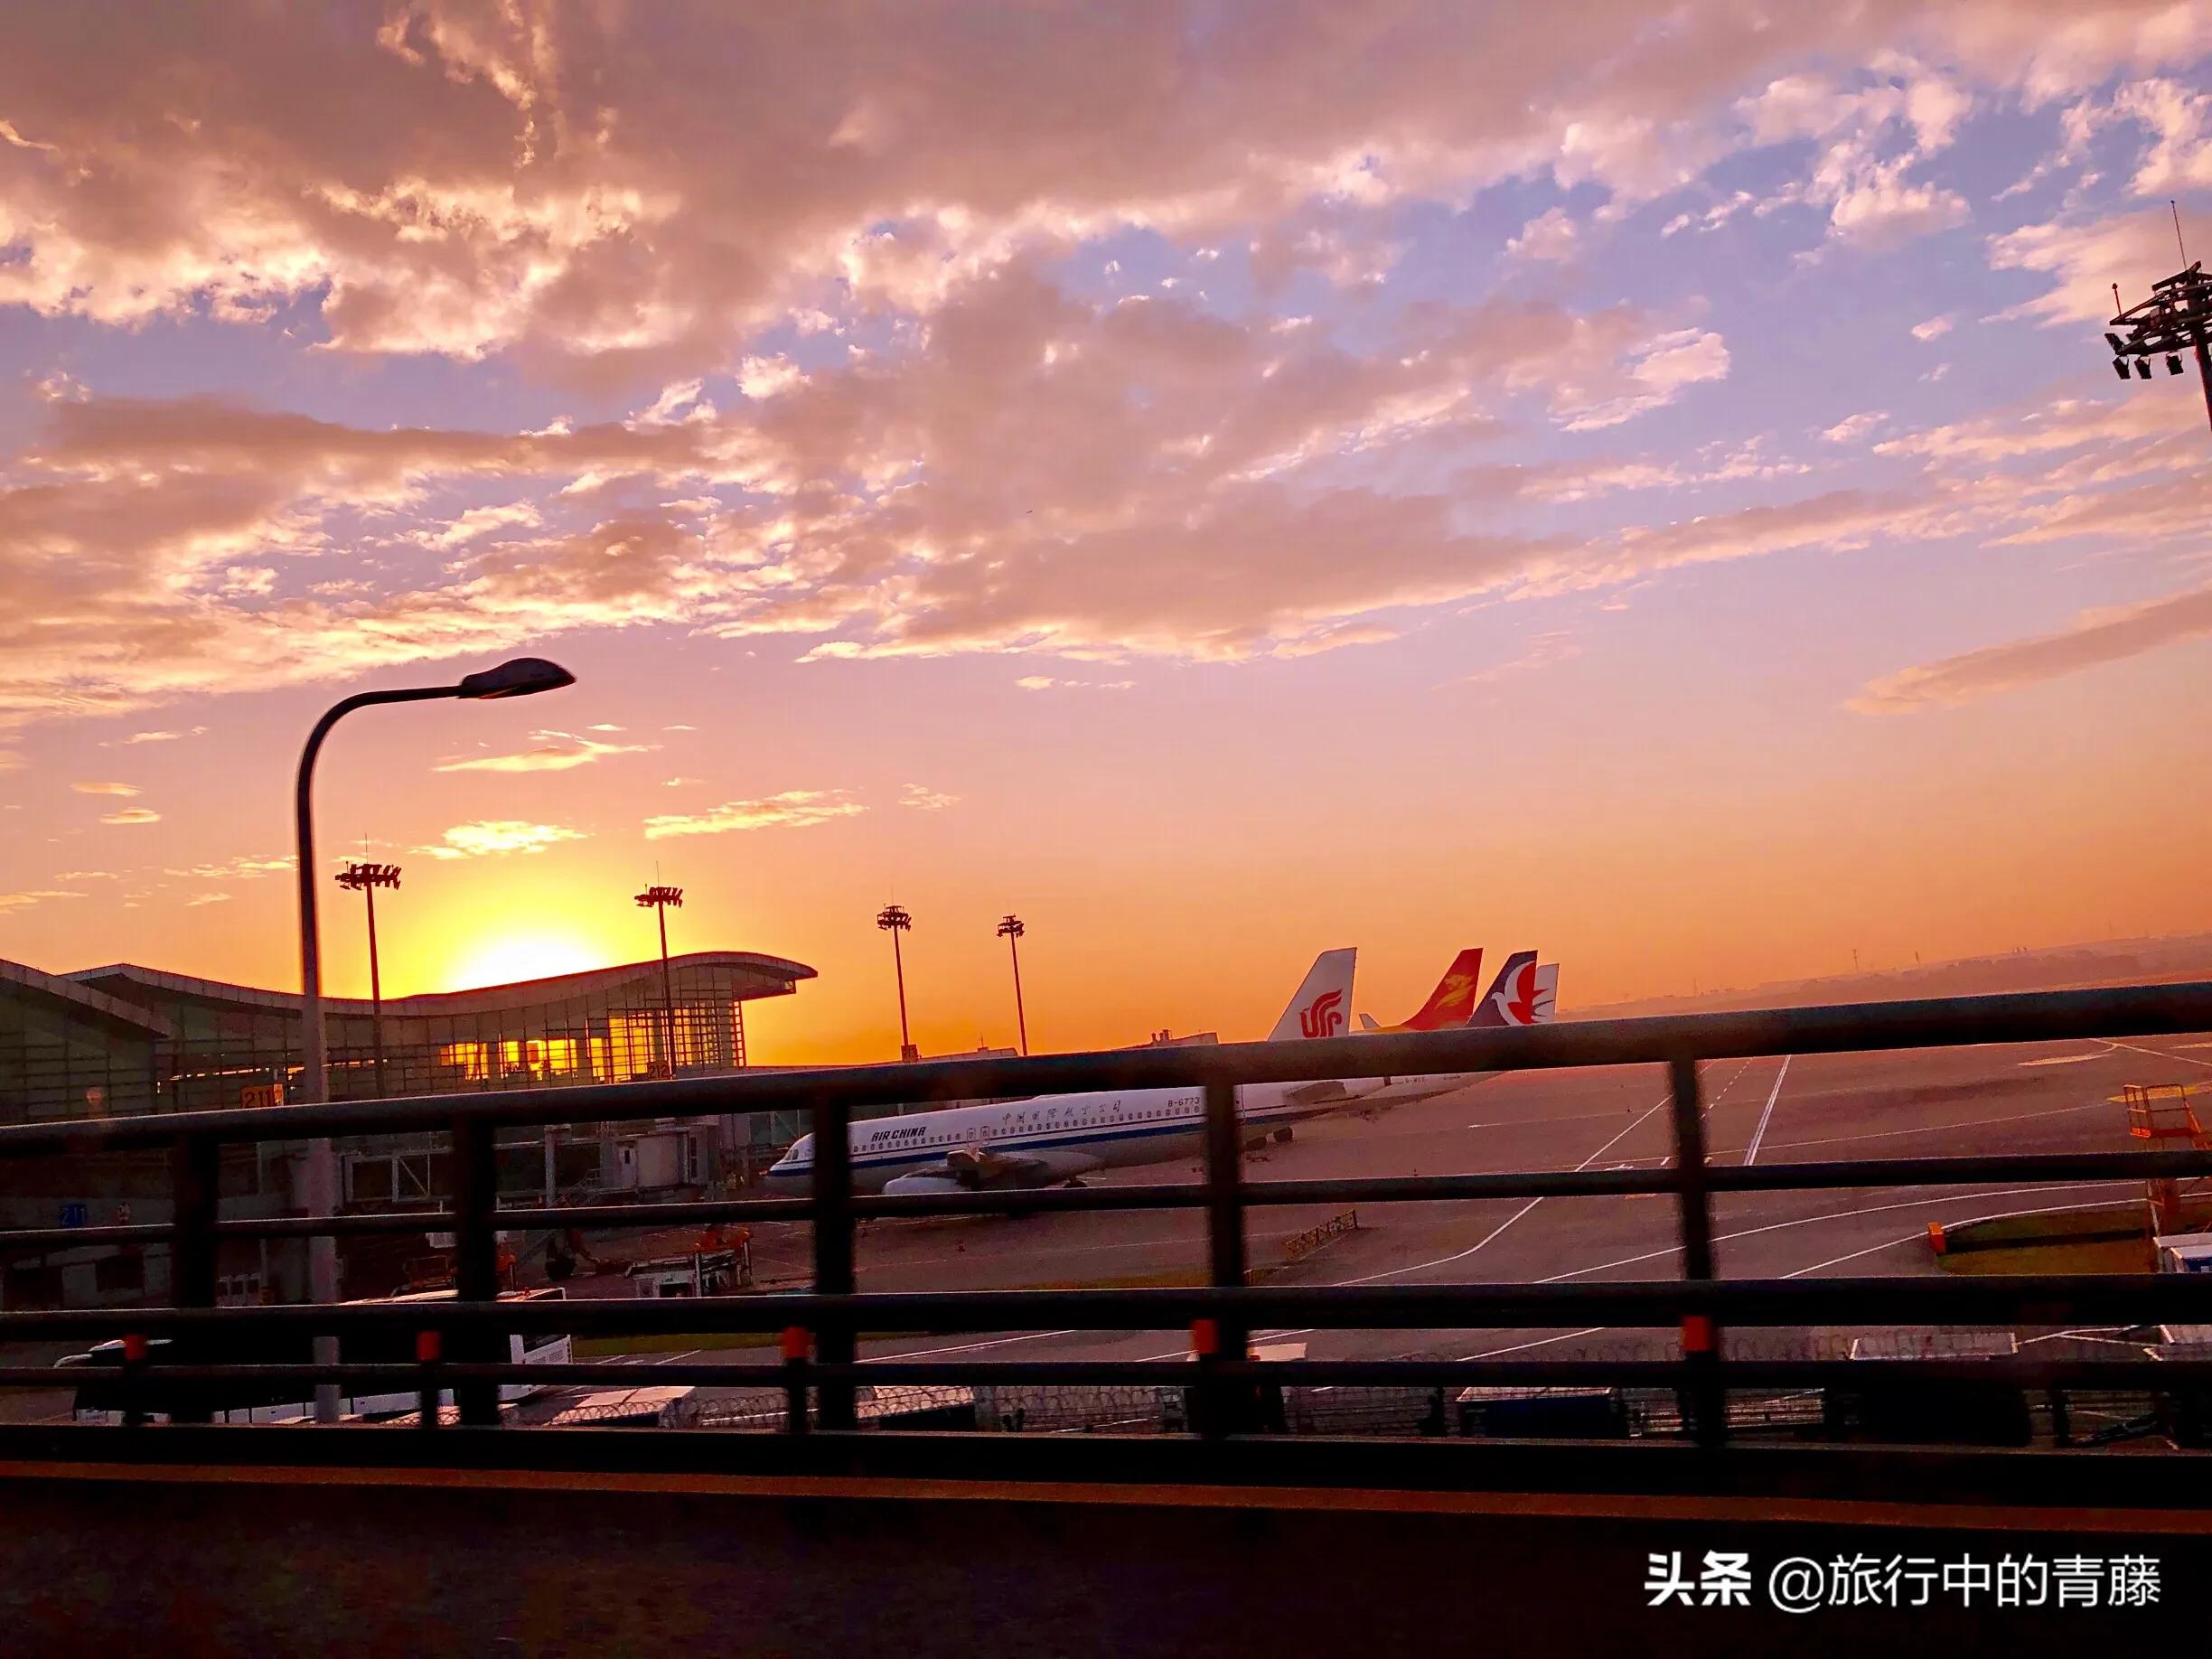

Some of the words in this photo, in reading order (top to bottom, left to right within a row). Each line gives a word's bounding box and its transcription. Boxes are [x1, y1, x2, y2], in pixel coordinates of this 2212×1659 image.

[1167, 1096, 1200, 1107] B-6773
[871, 1130, 890, 1142] AIR
[891, 1126, 927, 1139] CHINA
